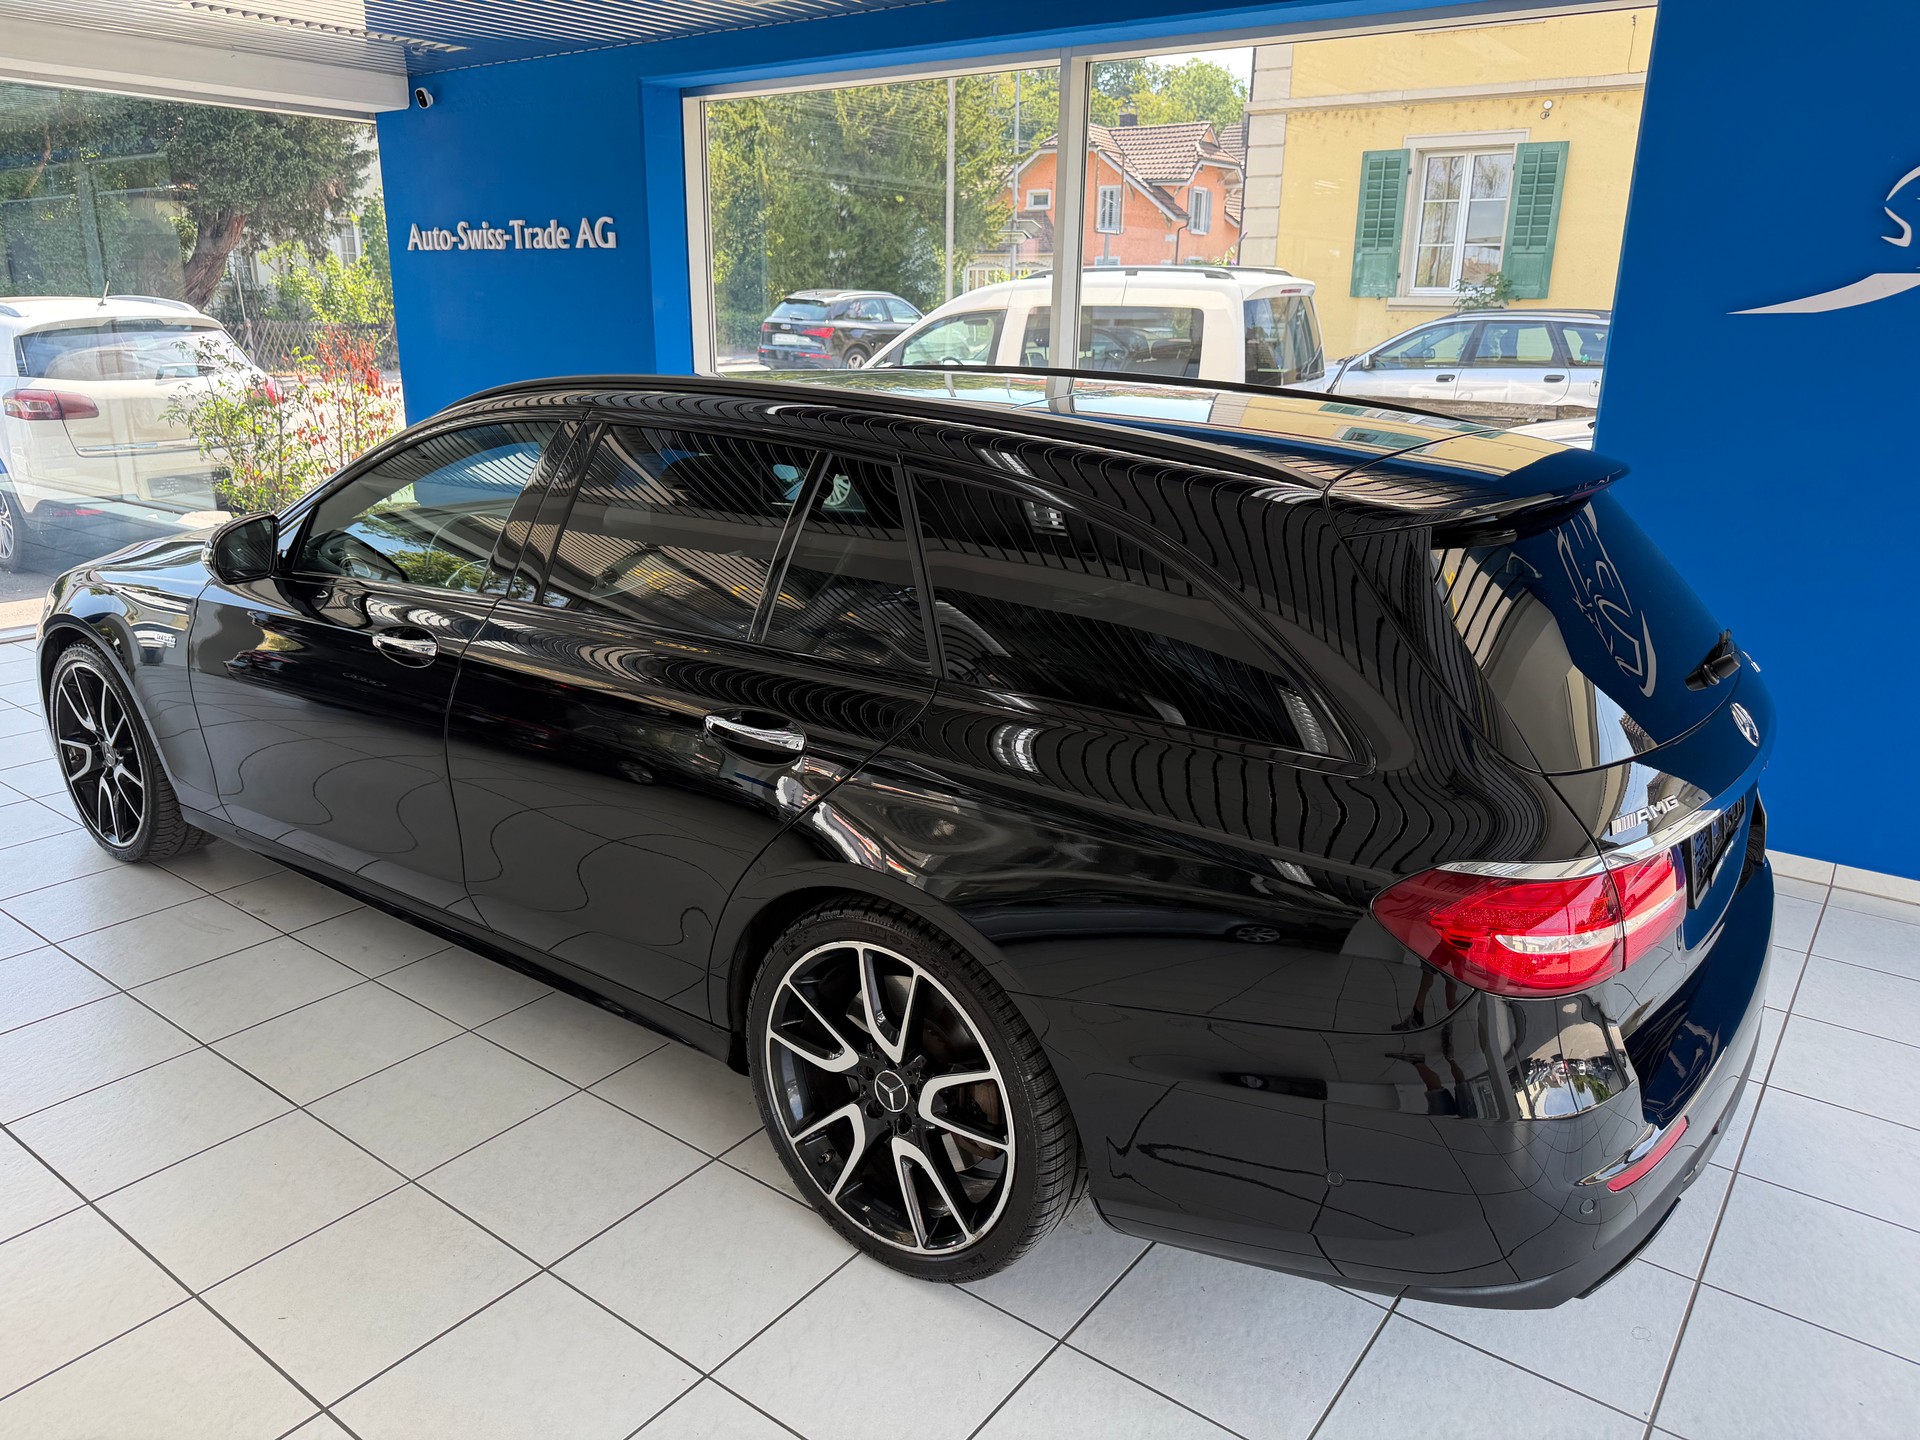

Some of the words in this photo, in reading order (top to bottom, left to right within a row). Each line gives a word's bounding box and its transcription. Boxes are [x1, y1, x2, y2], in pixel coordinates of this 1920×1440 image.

[407, 219, 570, 251] Auto-Swiss-Trade
[575, 216, 617, 249] AG
[1636, 794, 1680, 825] AMG
